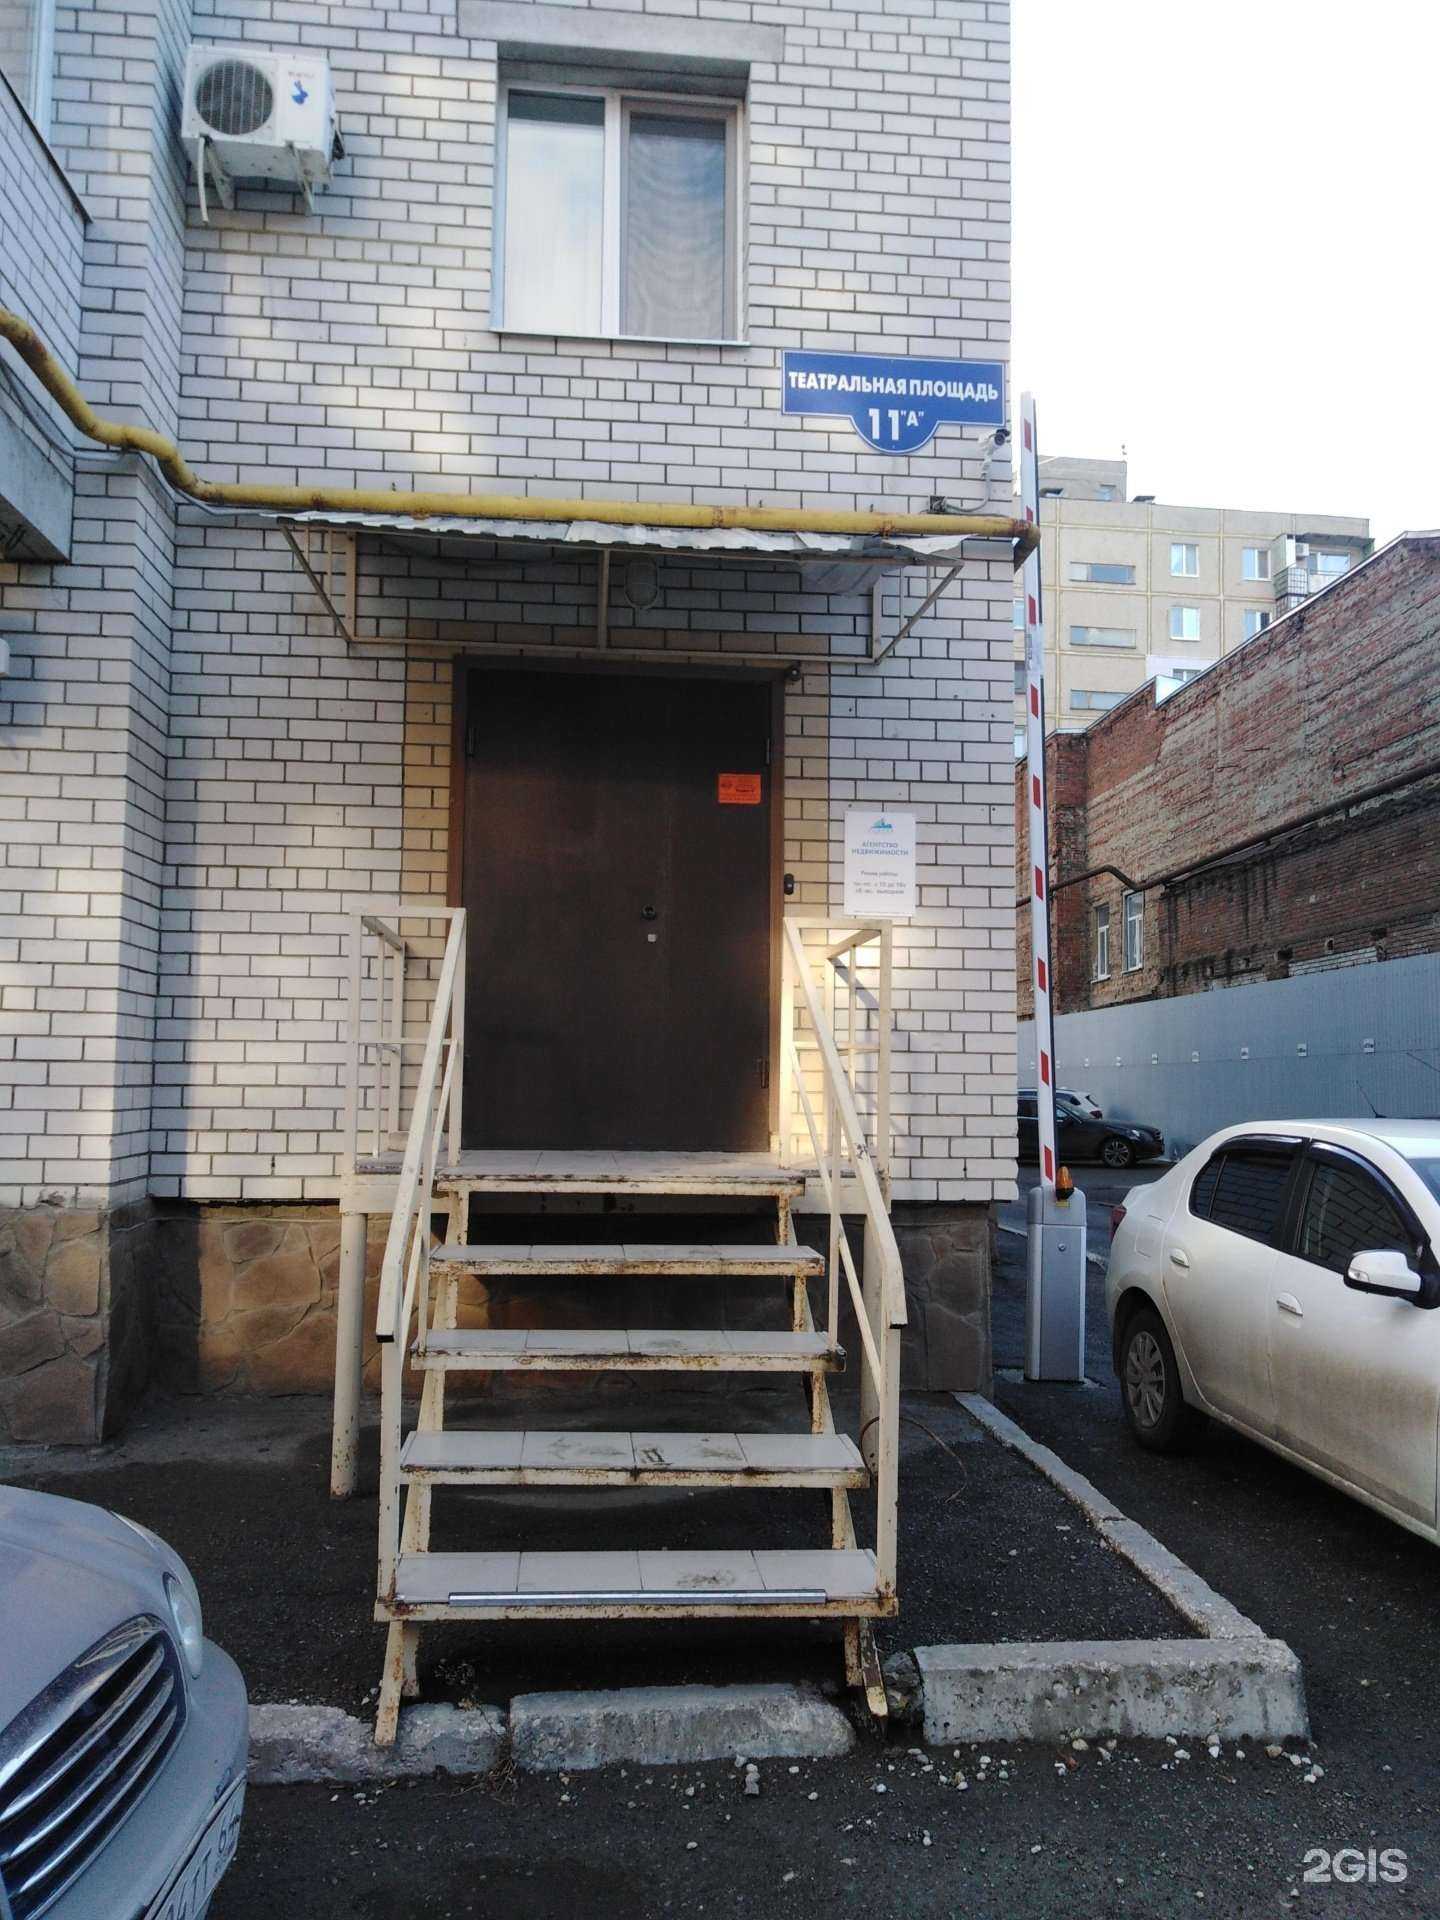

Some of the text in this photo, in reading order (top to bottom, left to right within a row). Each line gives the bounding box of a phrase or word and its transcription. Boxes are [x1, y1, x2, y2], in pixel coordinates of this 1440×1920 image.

[788, 371, 999, 402] ТЕАТРАЛЬНАЯ ПЛОЩАДЬ
[851, 848, 909, 856] НЕДВИЖИМОСТИ
